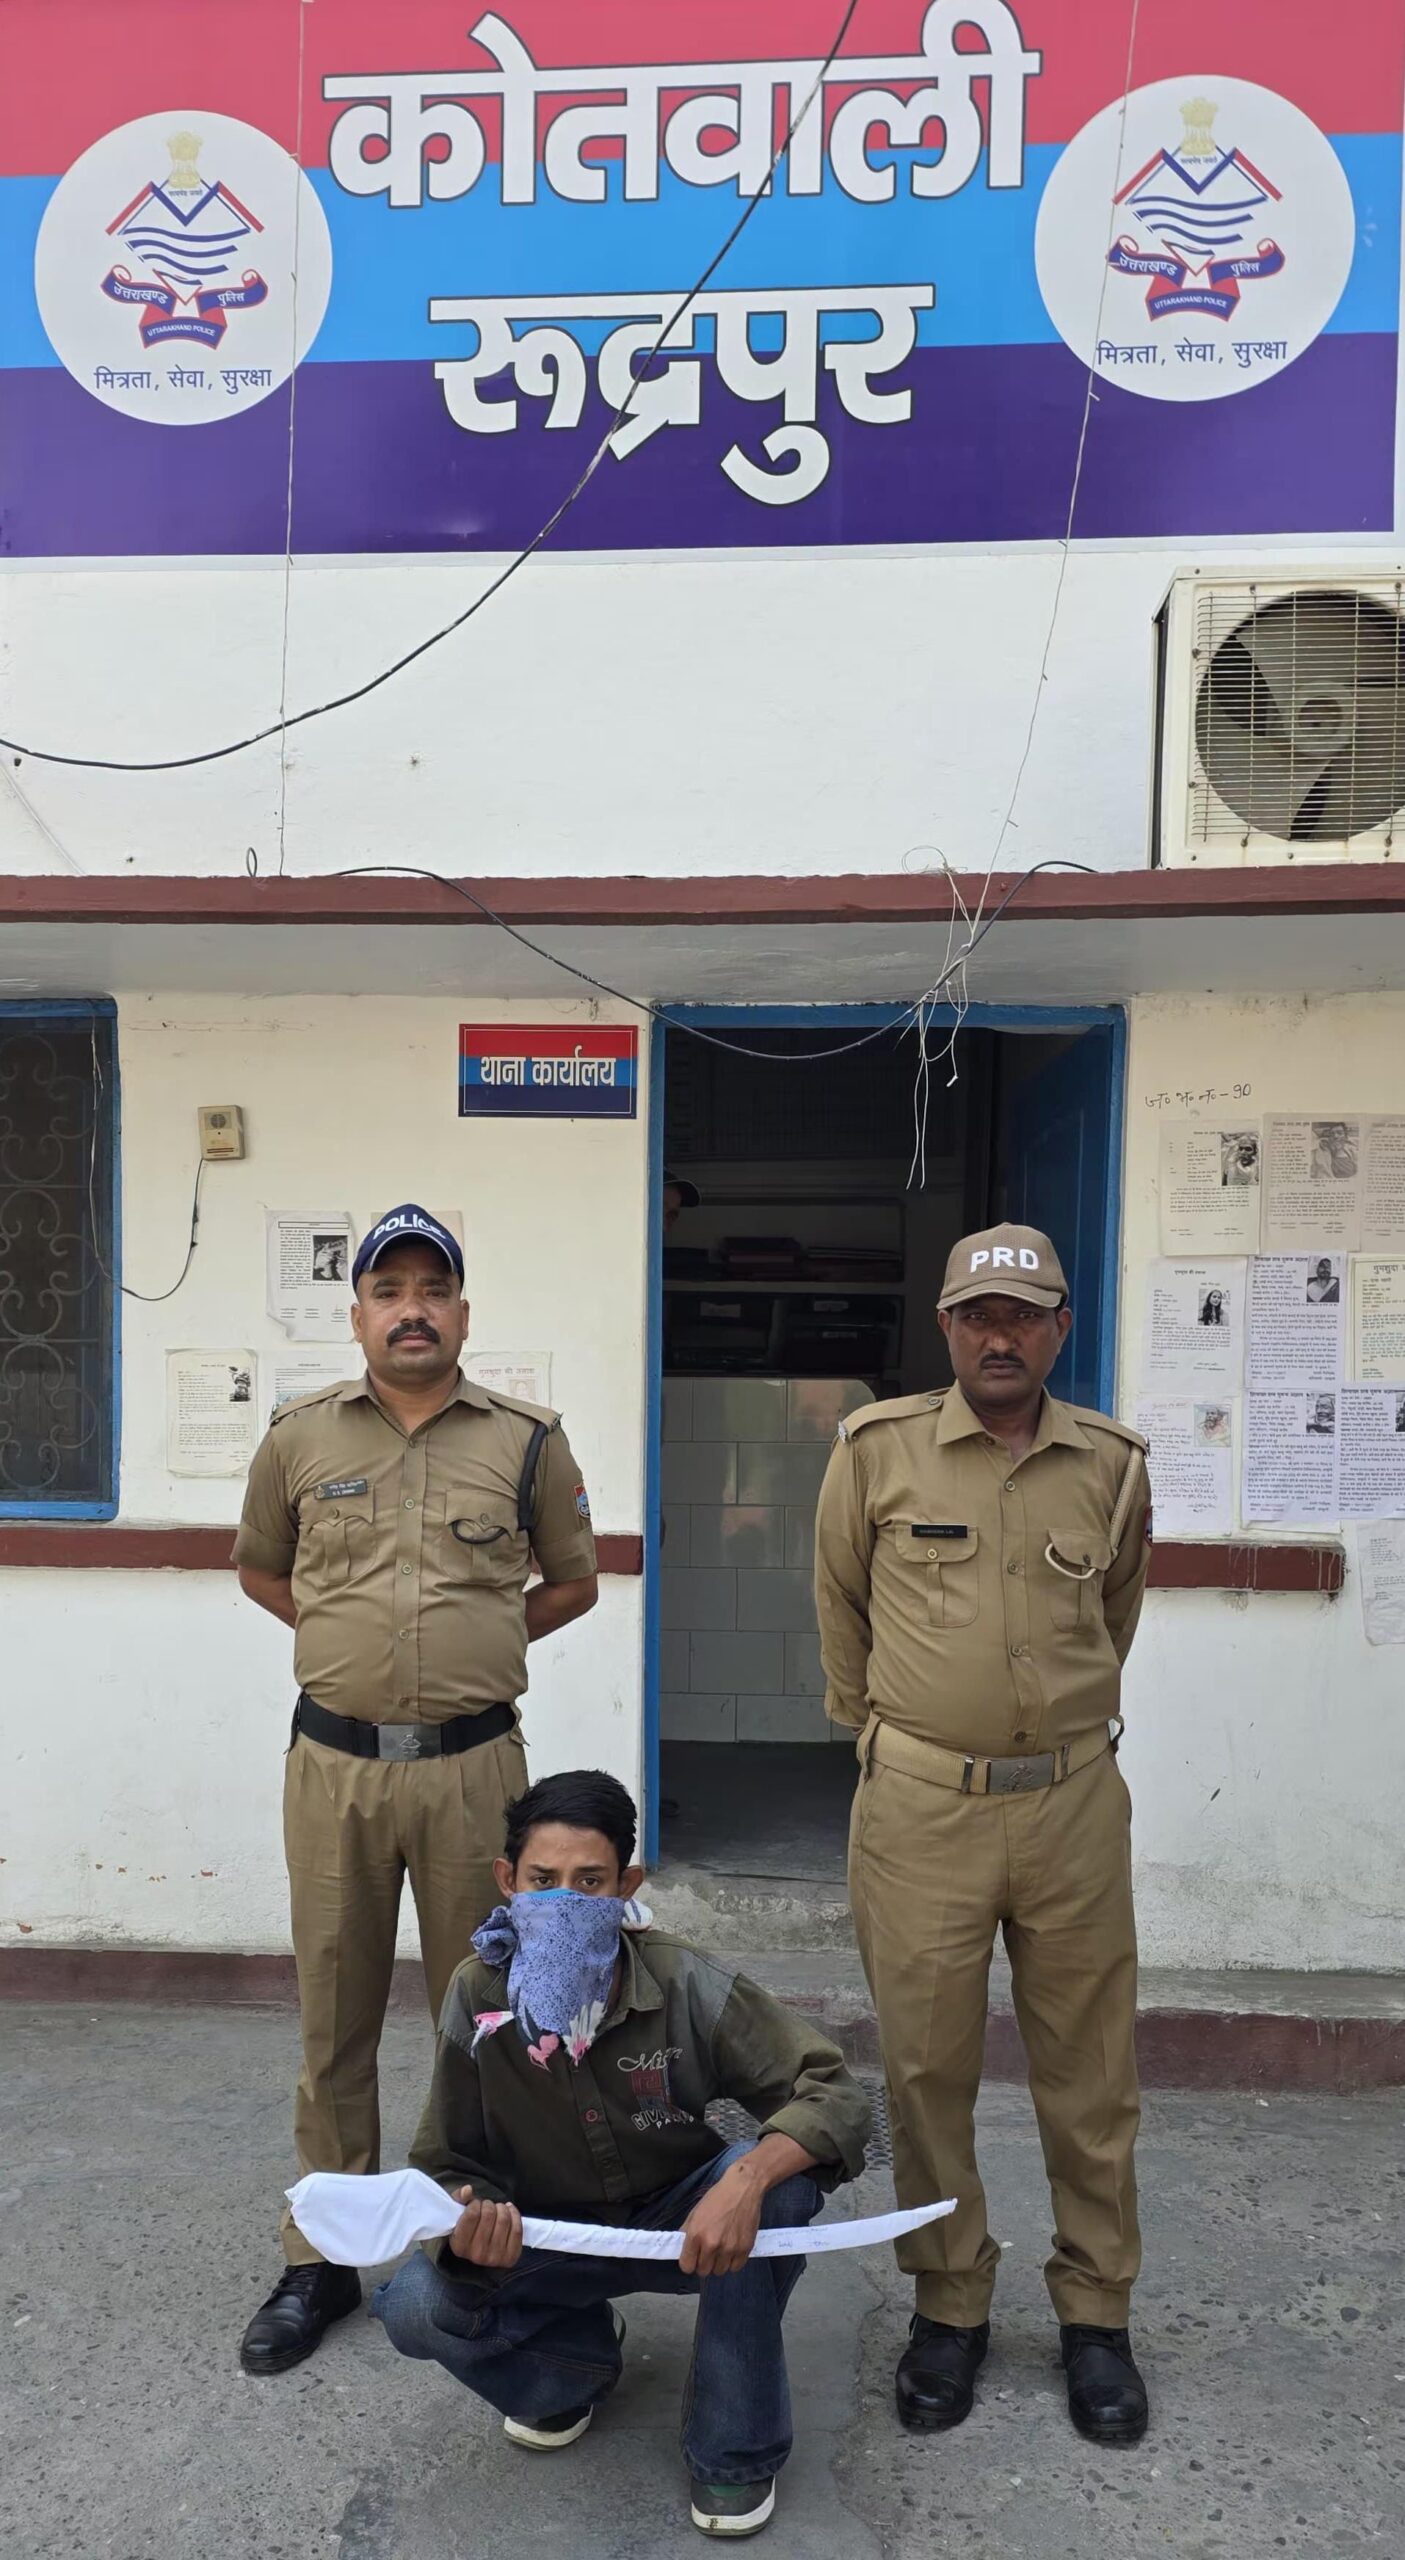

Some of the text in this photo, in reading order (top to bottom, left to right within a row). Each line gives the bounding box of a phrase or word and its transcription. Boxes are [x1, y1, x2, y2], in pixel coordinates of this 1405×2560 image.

[322, 0, 1043, 209] कोतवाली
[1230, 262, 1260, 277] पुलिस
[113, 282, 169, 305] उत्तराखण्ड
[217, 292, 245, 307] पुलिस
[1154, 295, 1227, 310] UTTARAKHAND POLICE
[147, 325, 216, 337] UTTARAKHAND POLICE
[1097, 336, 1288, 369] मित्रता, सेवा, सुरक्षा
[94, 364, 272, 395] मित्रता, सेवा, सुरक्षा
[480, 1045, 617, 1087] थाना कार्यालय
[373, 1213, 446, 1240] POLICE
[970, 1246, 1039, 1273] PRD
